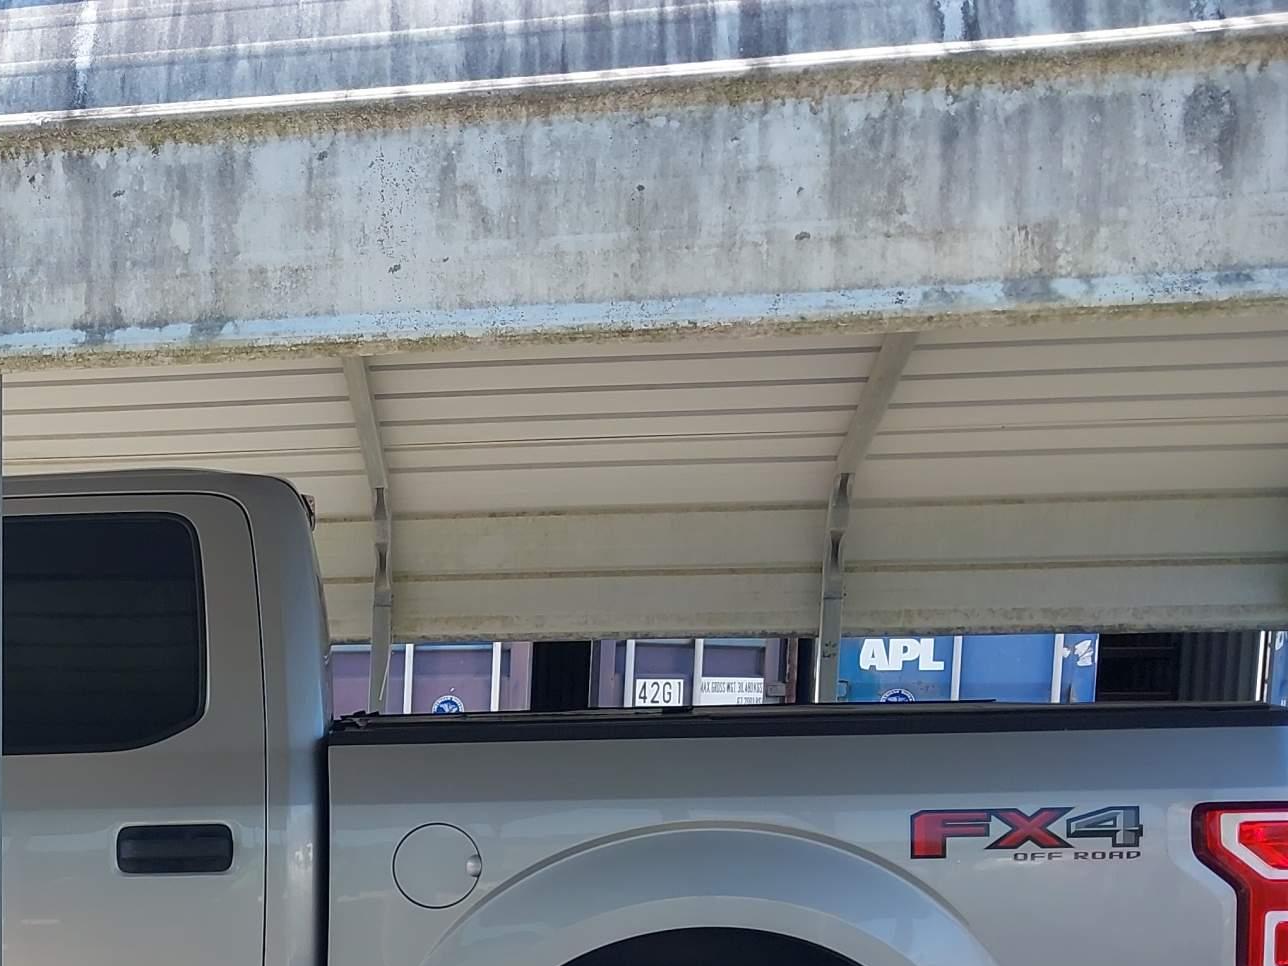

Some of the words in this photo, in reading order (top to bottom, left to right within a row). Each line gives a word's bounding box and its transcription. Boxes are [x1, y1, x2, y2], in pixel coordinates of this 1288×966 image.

[859, 638, 945, 671] APL
[638, 681, 682, 704] 42G1
[910, 806, 1144, 860] FX4
[1013, 851, 1063, 861] OFF
[1073, 850, 1141, 860] ROAD
